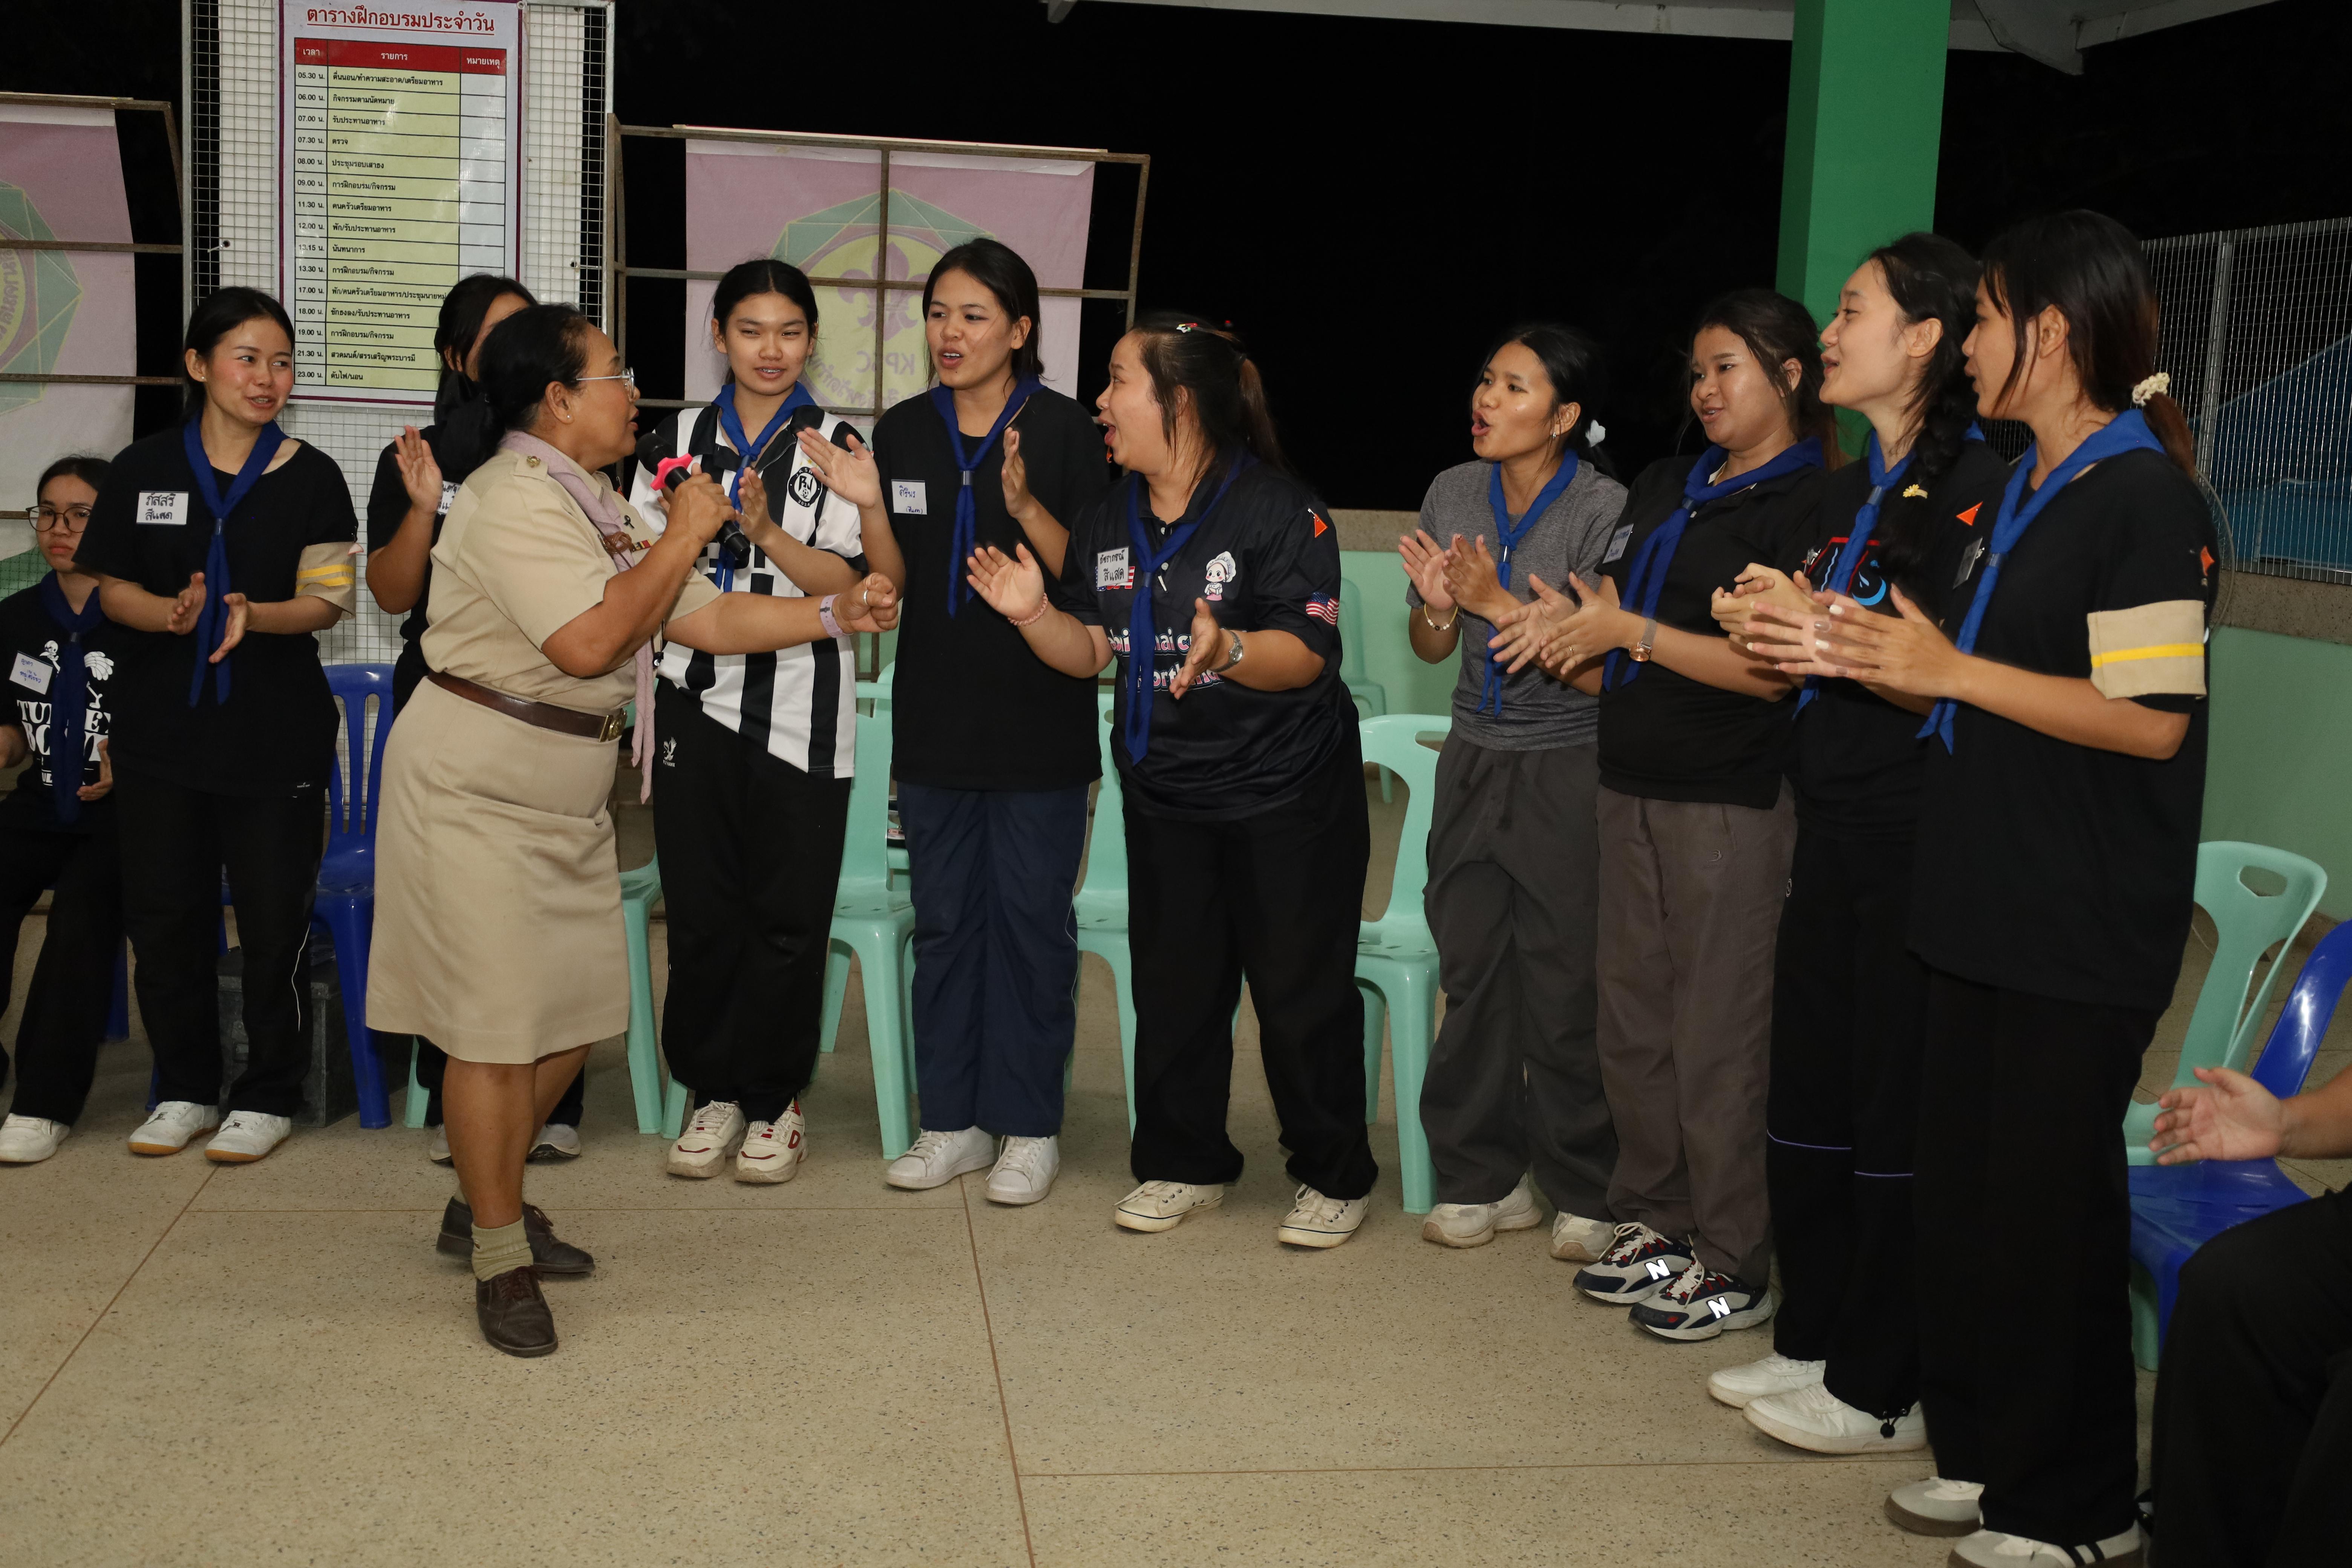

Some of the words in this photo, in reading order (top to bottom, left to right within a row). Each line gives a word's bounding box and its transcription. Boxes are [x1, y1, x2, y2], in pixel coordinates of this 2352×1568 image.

[307, 6, 495, 32] ตารางฝึกอบรมประจำวัน
[381, 52, 408, 61] รายการ
[466, 56, 500, 69] หมายเหตุ
[1103, 567, 1124, 582] สีแสด
